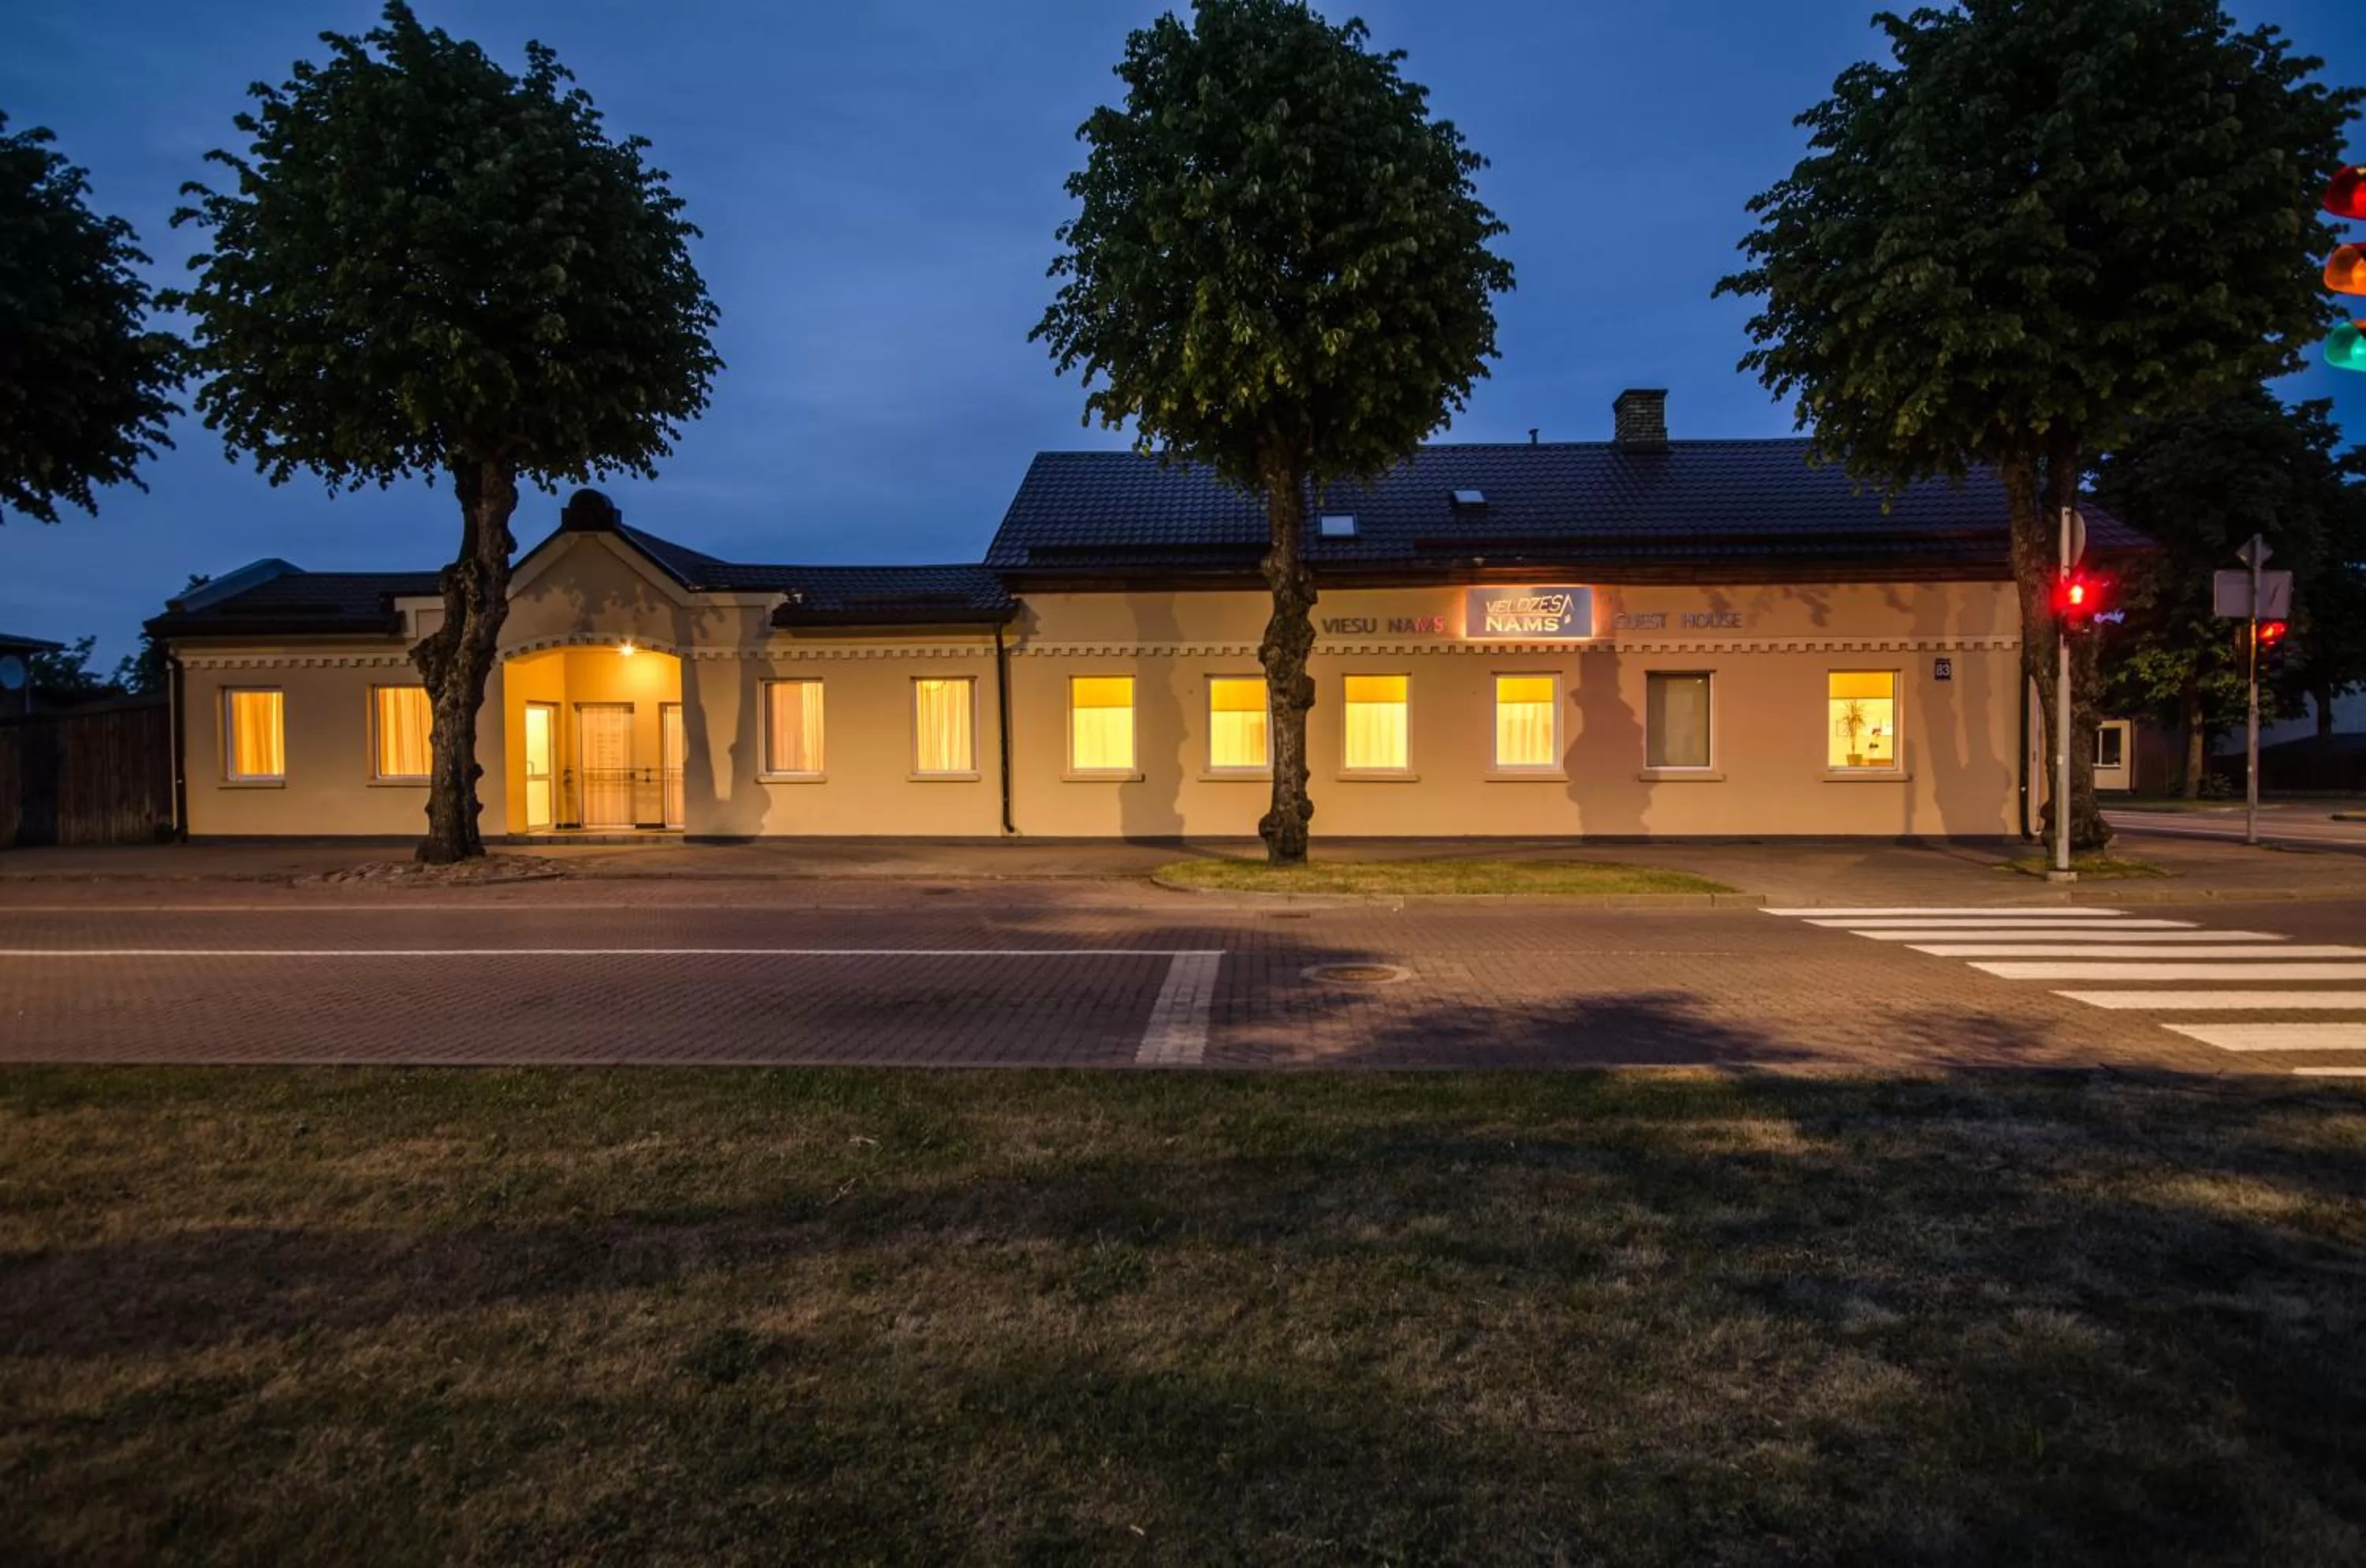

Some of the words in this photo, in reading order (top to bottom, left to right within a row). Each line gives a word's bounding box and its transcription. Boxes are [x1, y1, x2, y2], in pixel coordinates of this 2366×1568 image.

[1321, 618, 1378, 633] VIESU
[1388, 618, 1445, 633] NAMS
[1486, 616, 1559, 632] NAMS
[1680, 612, 1742, 629] HOUSE
[1936, 663, 1950, 676] 83
